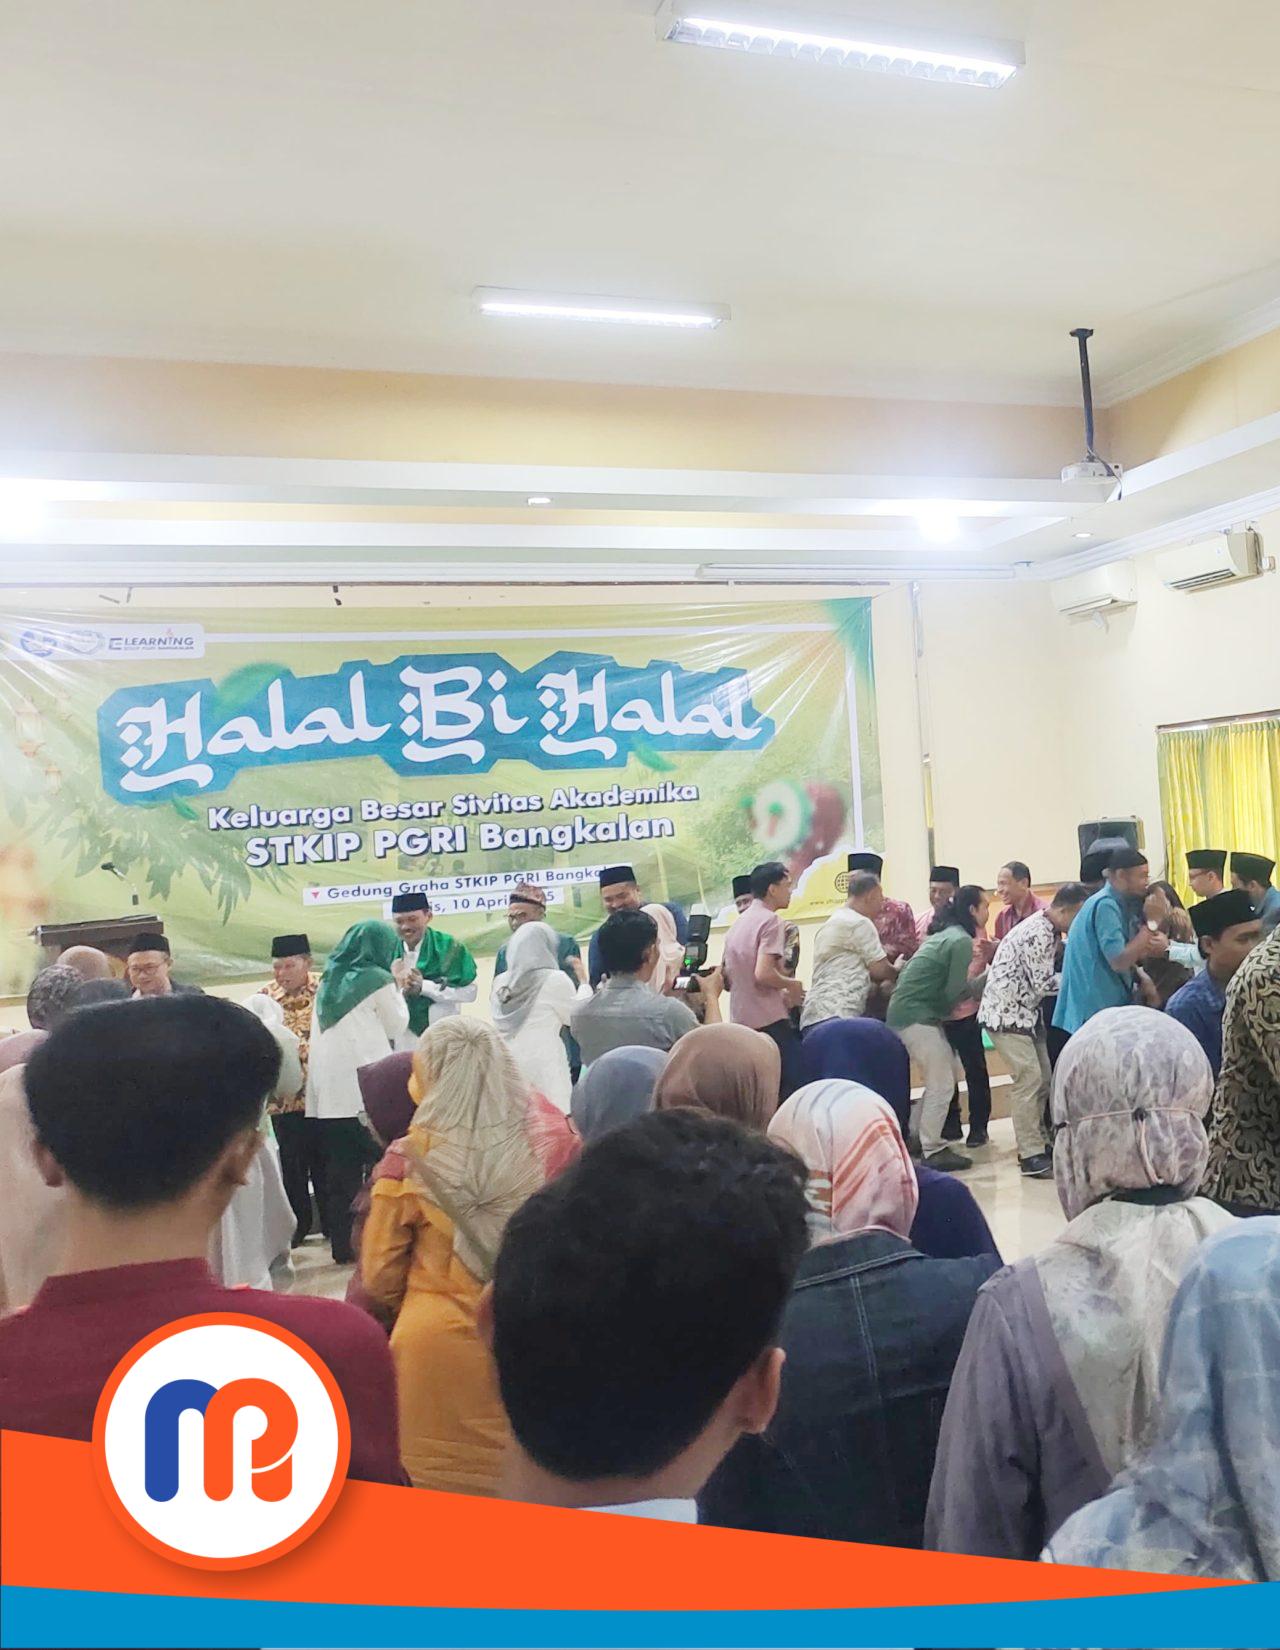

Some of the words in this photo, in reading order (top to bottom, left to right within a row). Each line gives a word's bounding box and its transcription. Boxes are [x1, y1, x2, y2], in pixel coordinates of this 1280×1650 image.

[116, 670, 392, 792] Halal
[399, 665, 529, 764] Bi
[536, 668, 762, 760] Halal
[208, 803, 351, 830] Keluarga
[360, 799, 446, 821] Besar
[452, 791, 543, 816] Sivitas
[549, 780, 698, 809] Akademika
[246, 832, 361, 867] STKIP
[374, 825, 467, 858] PGRI
[479, 813, 674, 851] Bangkalan
[327, 885, 393, 899] Gedung
[398, 879, 450, 894] Graha
[455, 875, 498, 889] STKIP
[504, 872, 540, 884] PGRI
[453, 899, 470, 910] 10
[476, 894, 507, 910] Apri
